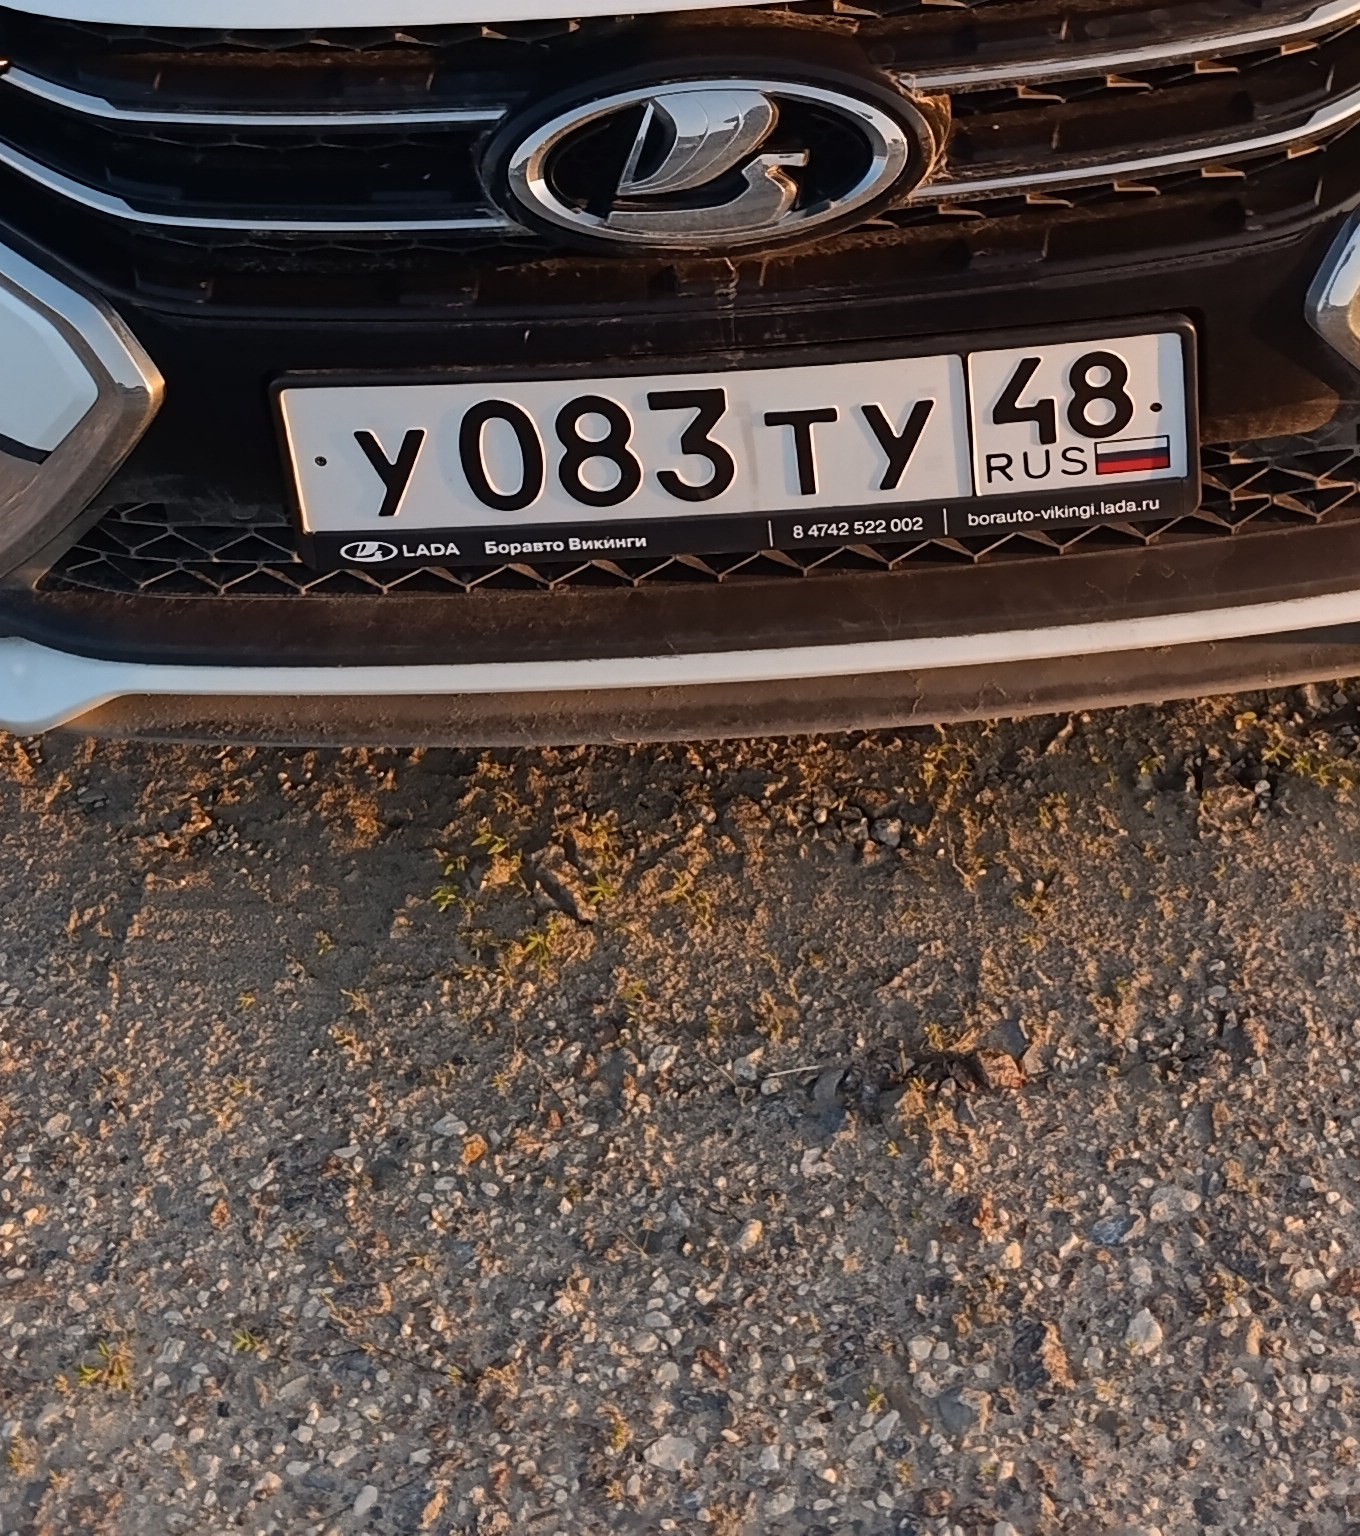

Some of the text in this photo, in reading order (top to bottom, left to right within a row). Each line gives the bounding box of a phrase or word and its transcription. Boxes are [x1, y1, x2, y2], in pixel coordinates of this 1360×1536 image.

[991, 350, 1135, 445] 48
[985, 445, 1089, 484] RUS
[967, 497, 1161, 527] borauto-vikingi.lada.ru
[792, 516, 924, 539] 8 4742 522 002
[402, 541, 460, 558] LADA
[484, 537, 648, 556] Боравто Викинги
